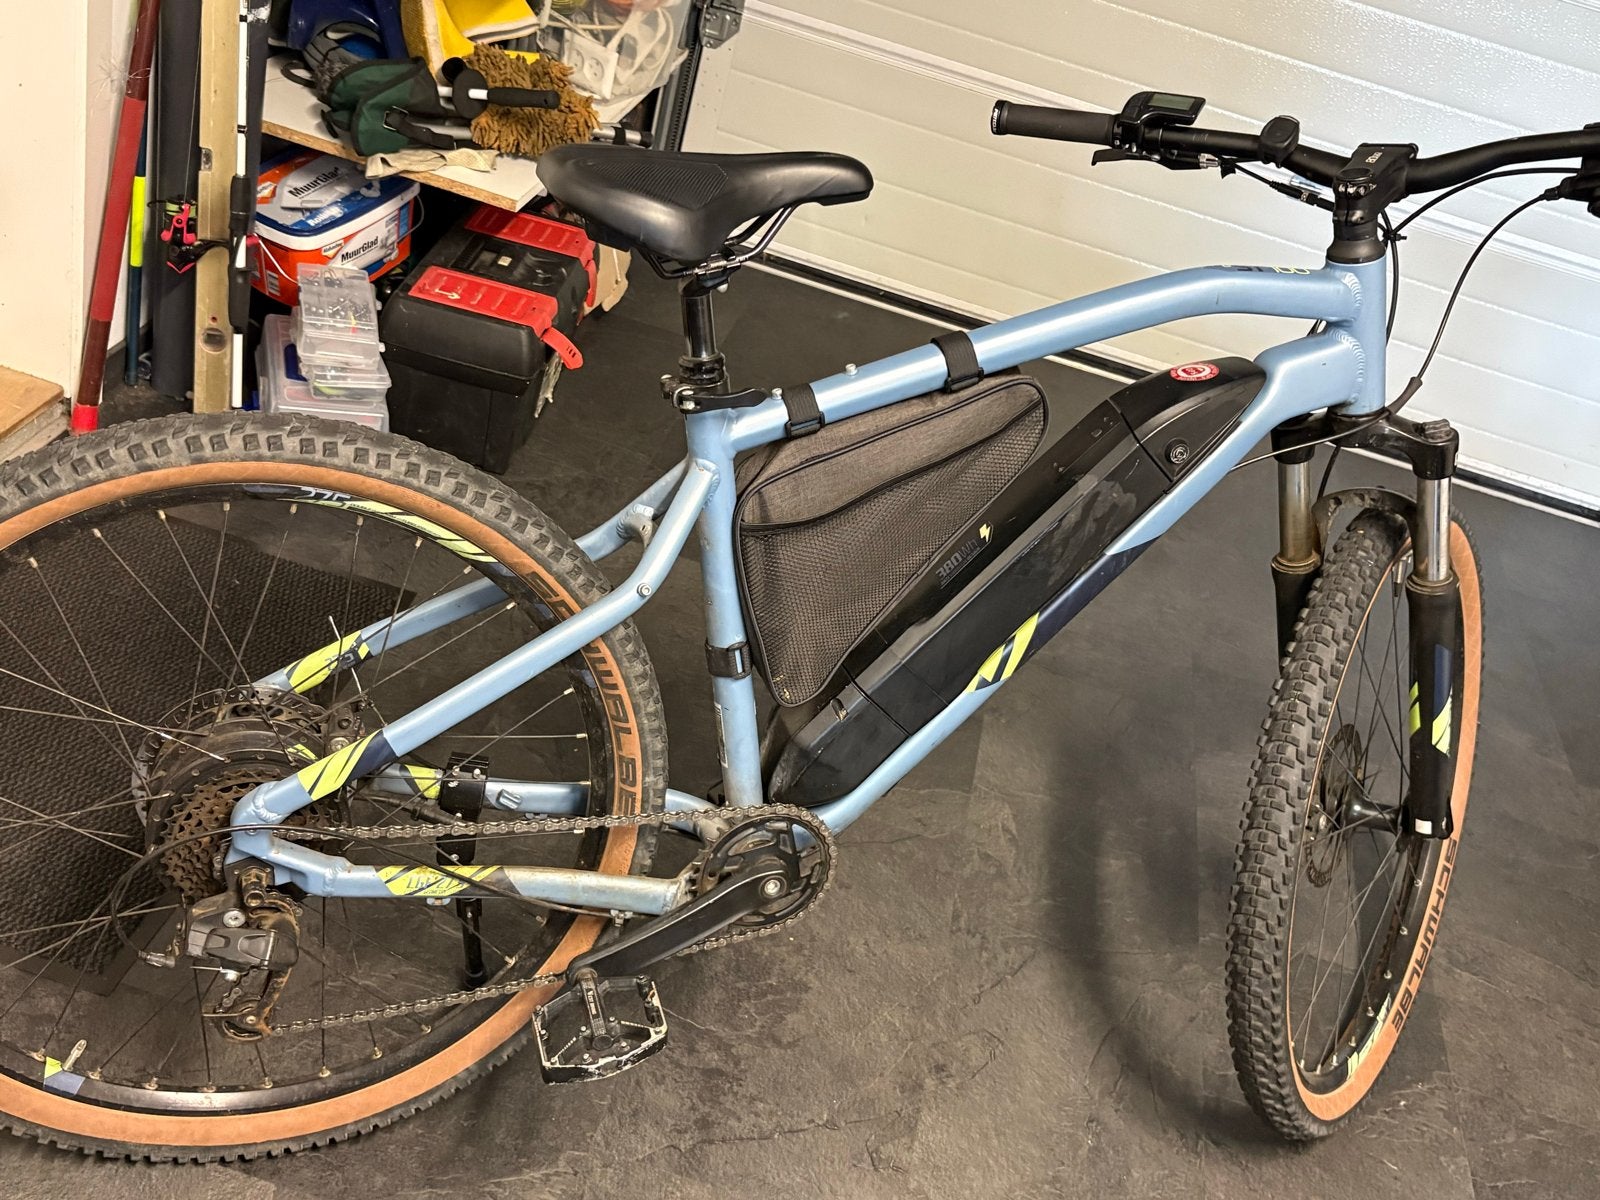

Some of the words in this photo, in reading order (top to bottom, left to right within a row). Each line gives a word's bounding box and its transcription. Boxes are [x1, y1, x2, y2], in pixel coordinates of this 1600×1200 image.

[341, 237, 379, 263] MuurGlad
[936, 539, 978, 579] 380Wh
[1391, 837, 1458, 1034] SCHWALBE
